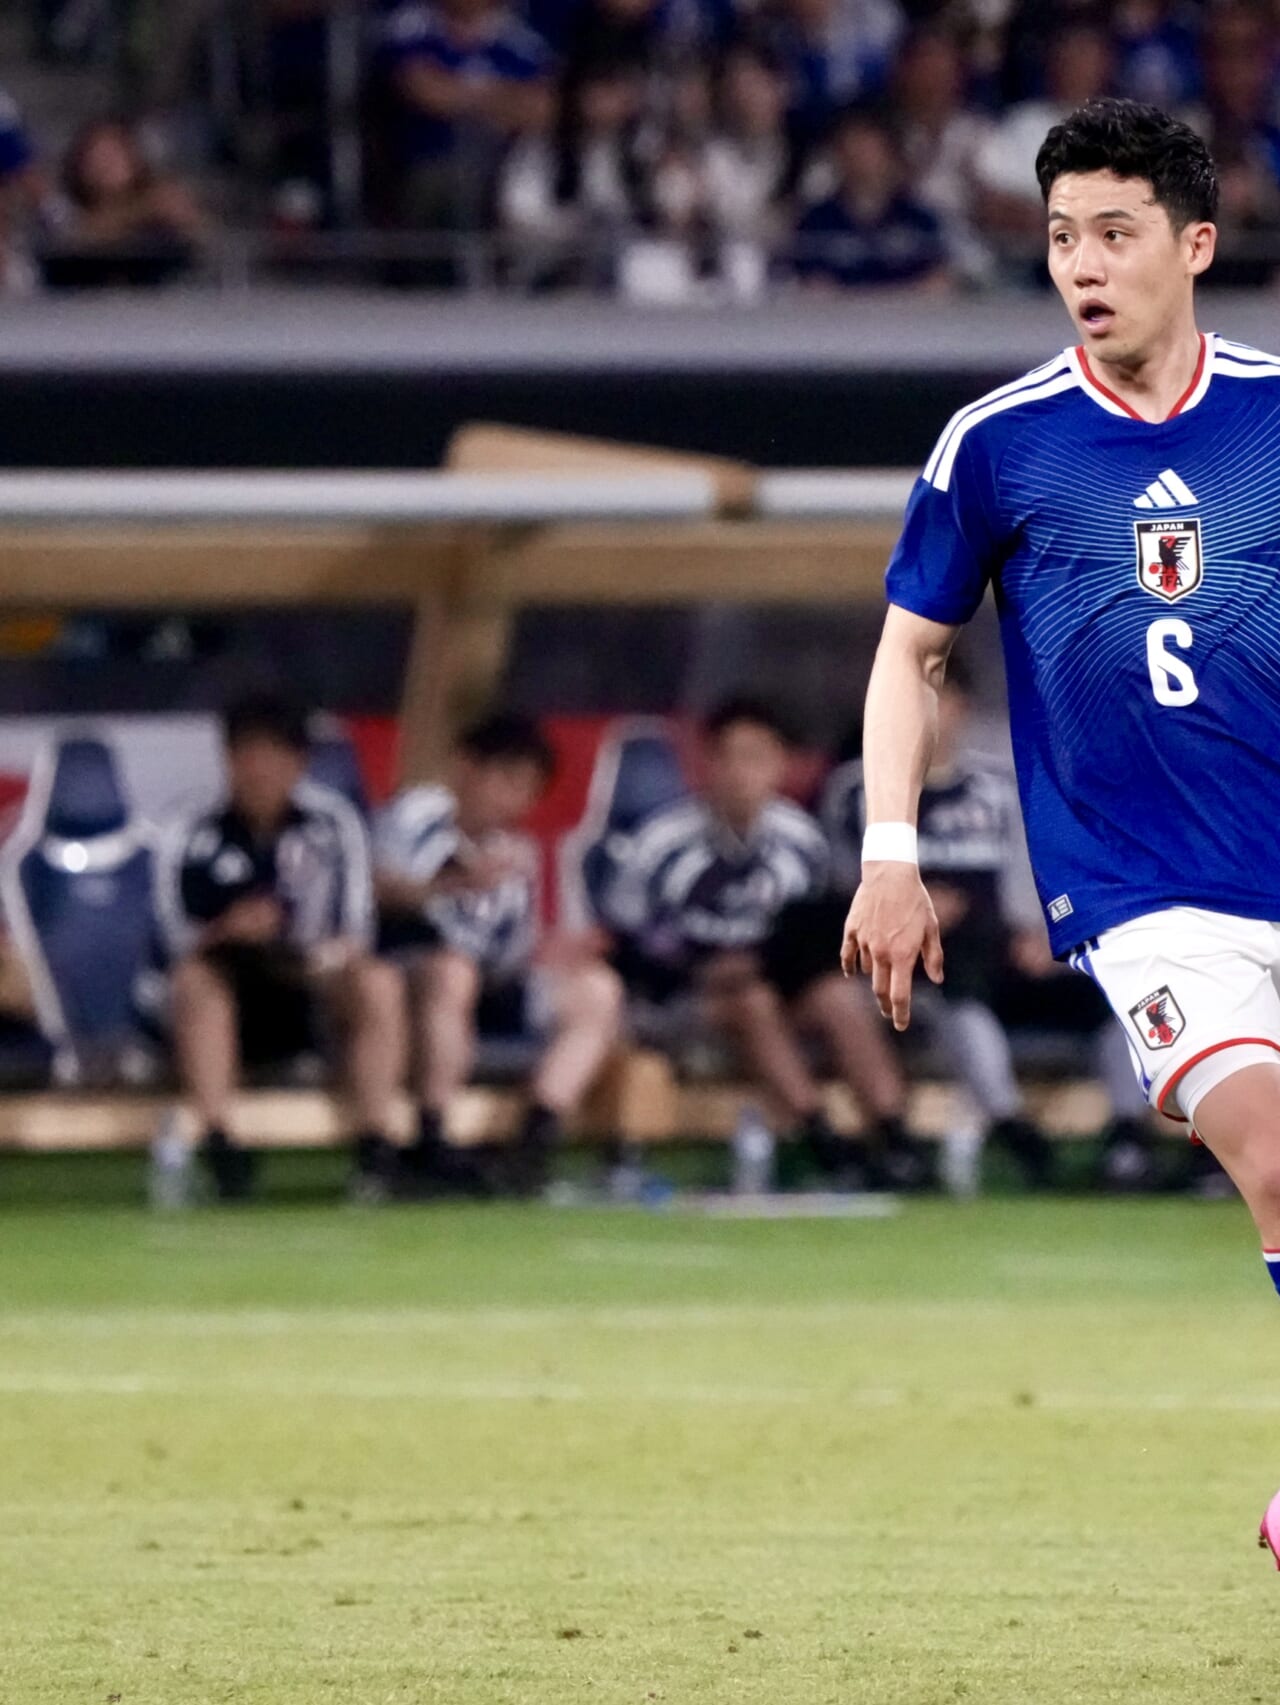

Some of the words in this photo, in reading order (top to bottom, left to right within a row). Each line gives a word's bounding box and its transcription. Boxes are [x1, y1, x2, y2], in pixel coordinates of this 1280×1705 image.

[1150, 522, 1185, 532] JAPAN
[1156, 575, 1184, 588] JFA
[1146, 618, 1199, 707] 6
[1136, 990, 1160, 1010] JAPAN
